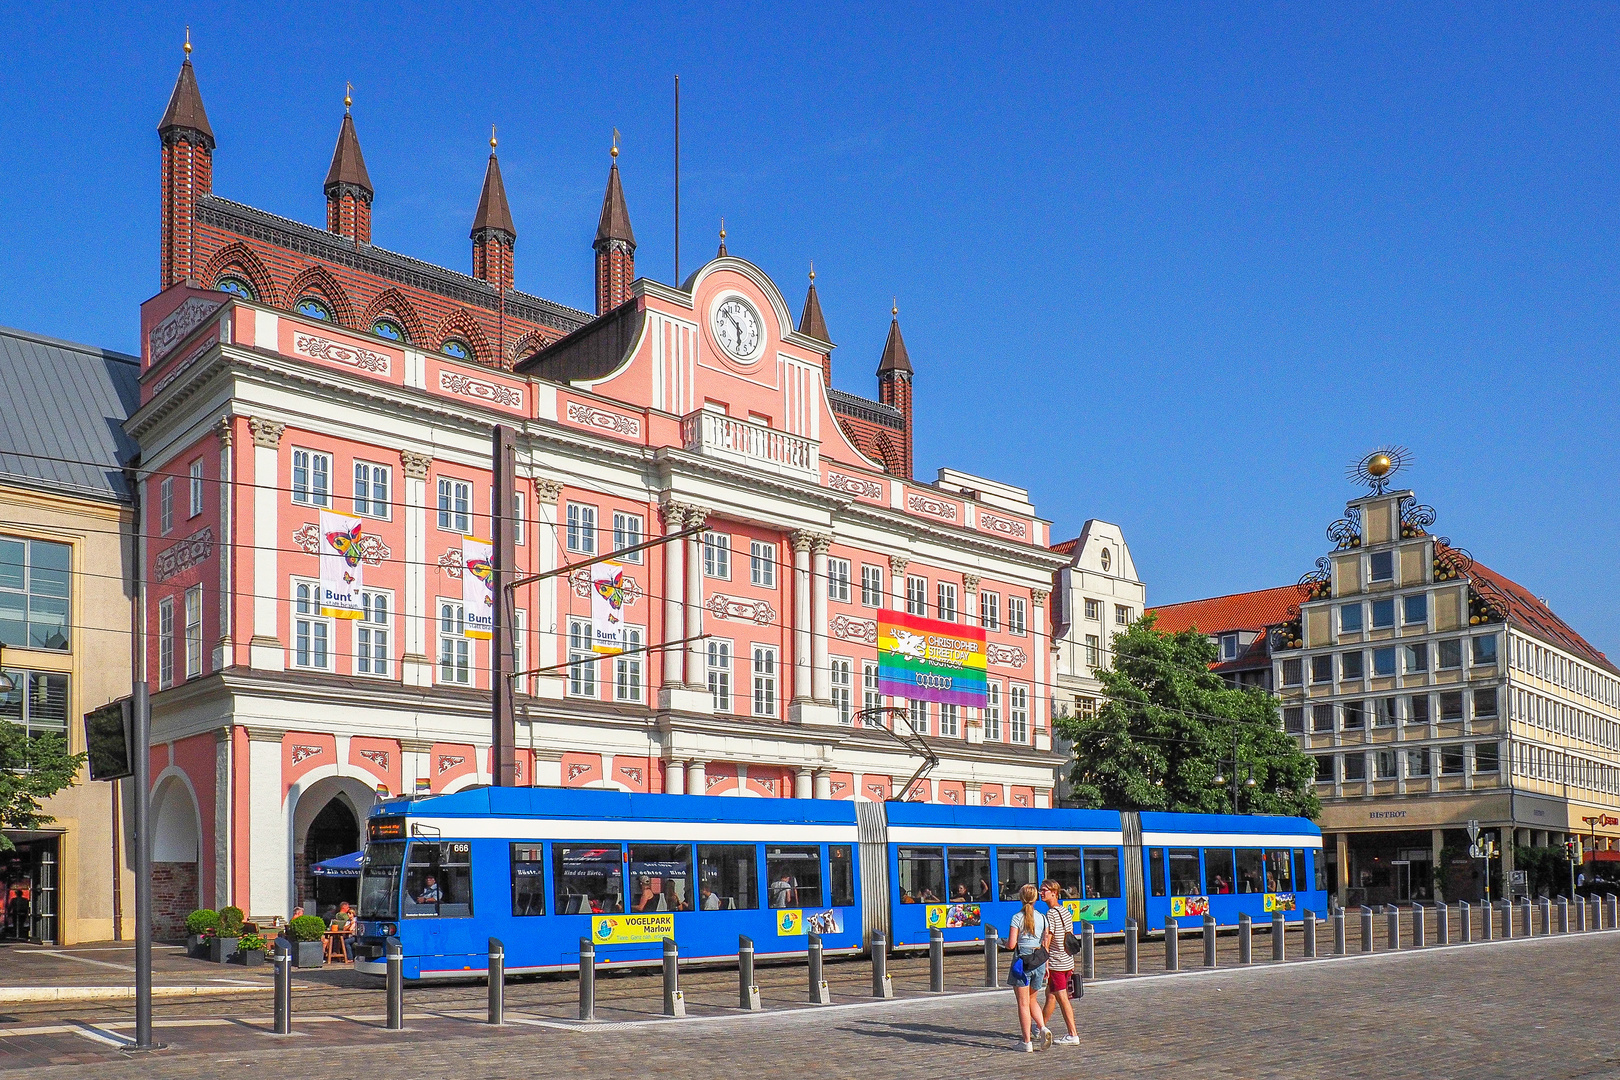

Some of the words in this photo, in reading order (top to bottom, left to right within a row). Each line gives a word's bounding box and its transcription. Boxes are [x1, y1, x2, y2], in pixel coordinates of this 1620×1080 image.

[735, 305, 740, 313] 12
[727, 339, 731, 347] 7
[326, 590, 352, 601] Bunt
[468, 613, 491, 624] Bunt
[597, 630, 616, 640] Bunt
[928, 636, 978, 652] CHRISTOPHER
[928, 646, 954, 659] STREET
[955, 650, 970, 661] DAY
[928, 656, 964, 670] ROSTOCK
[626, 917, 670, 925] VOGELPARK
